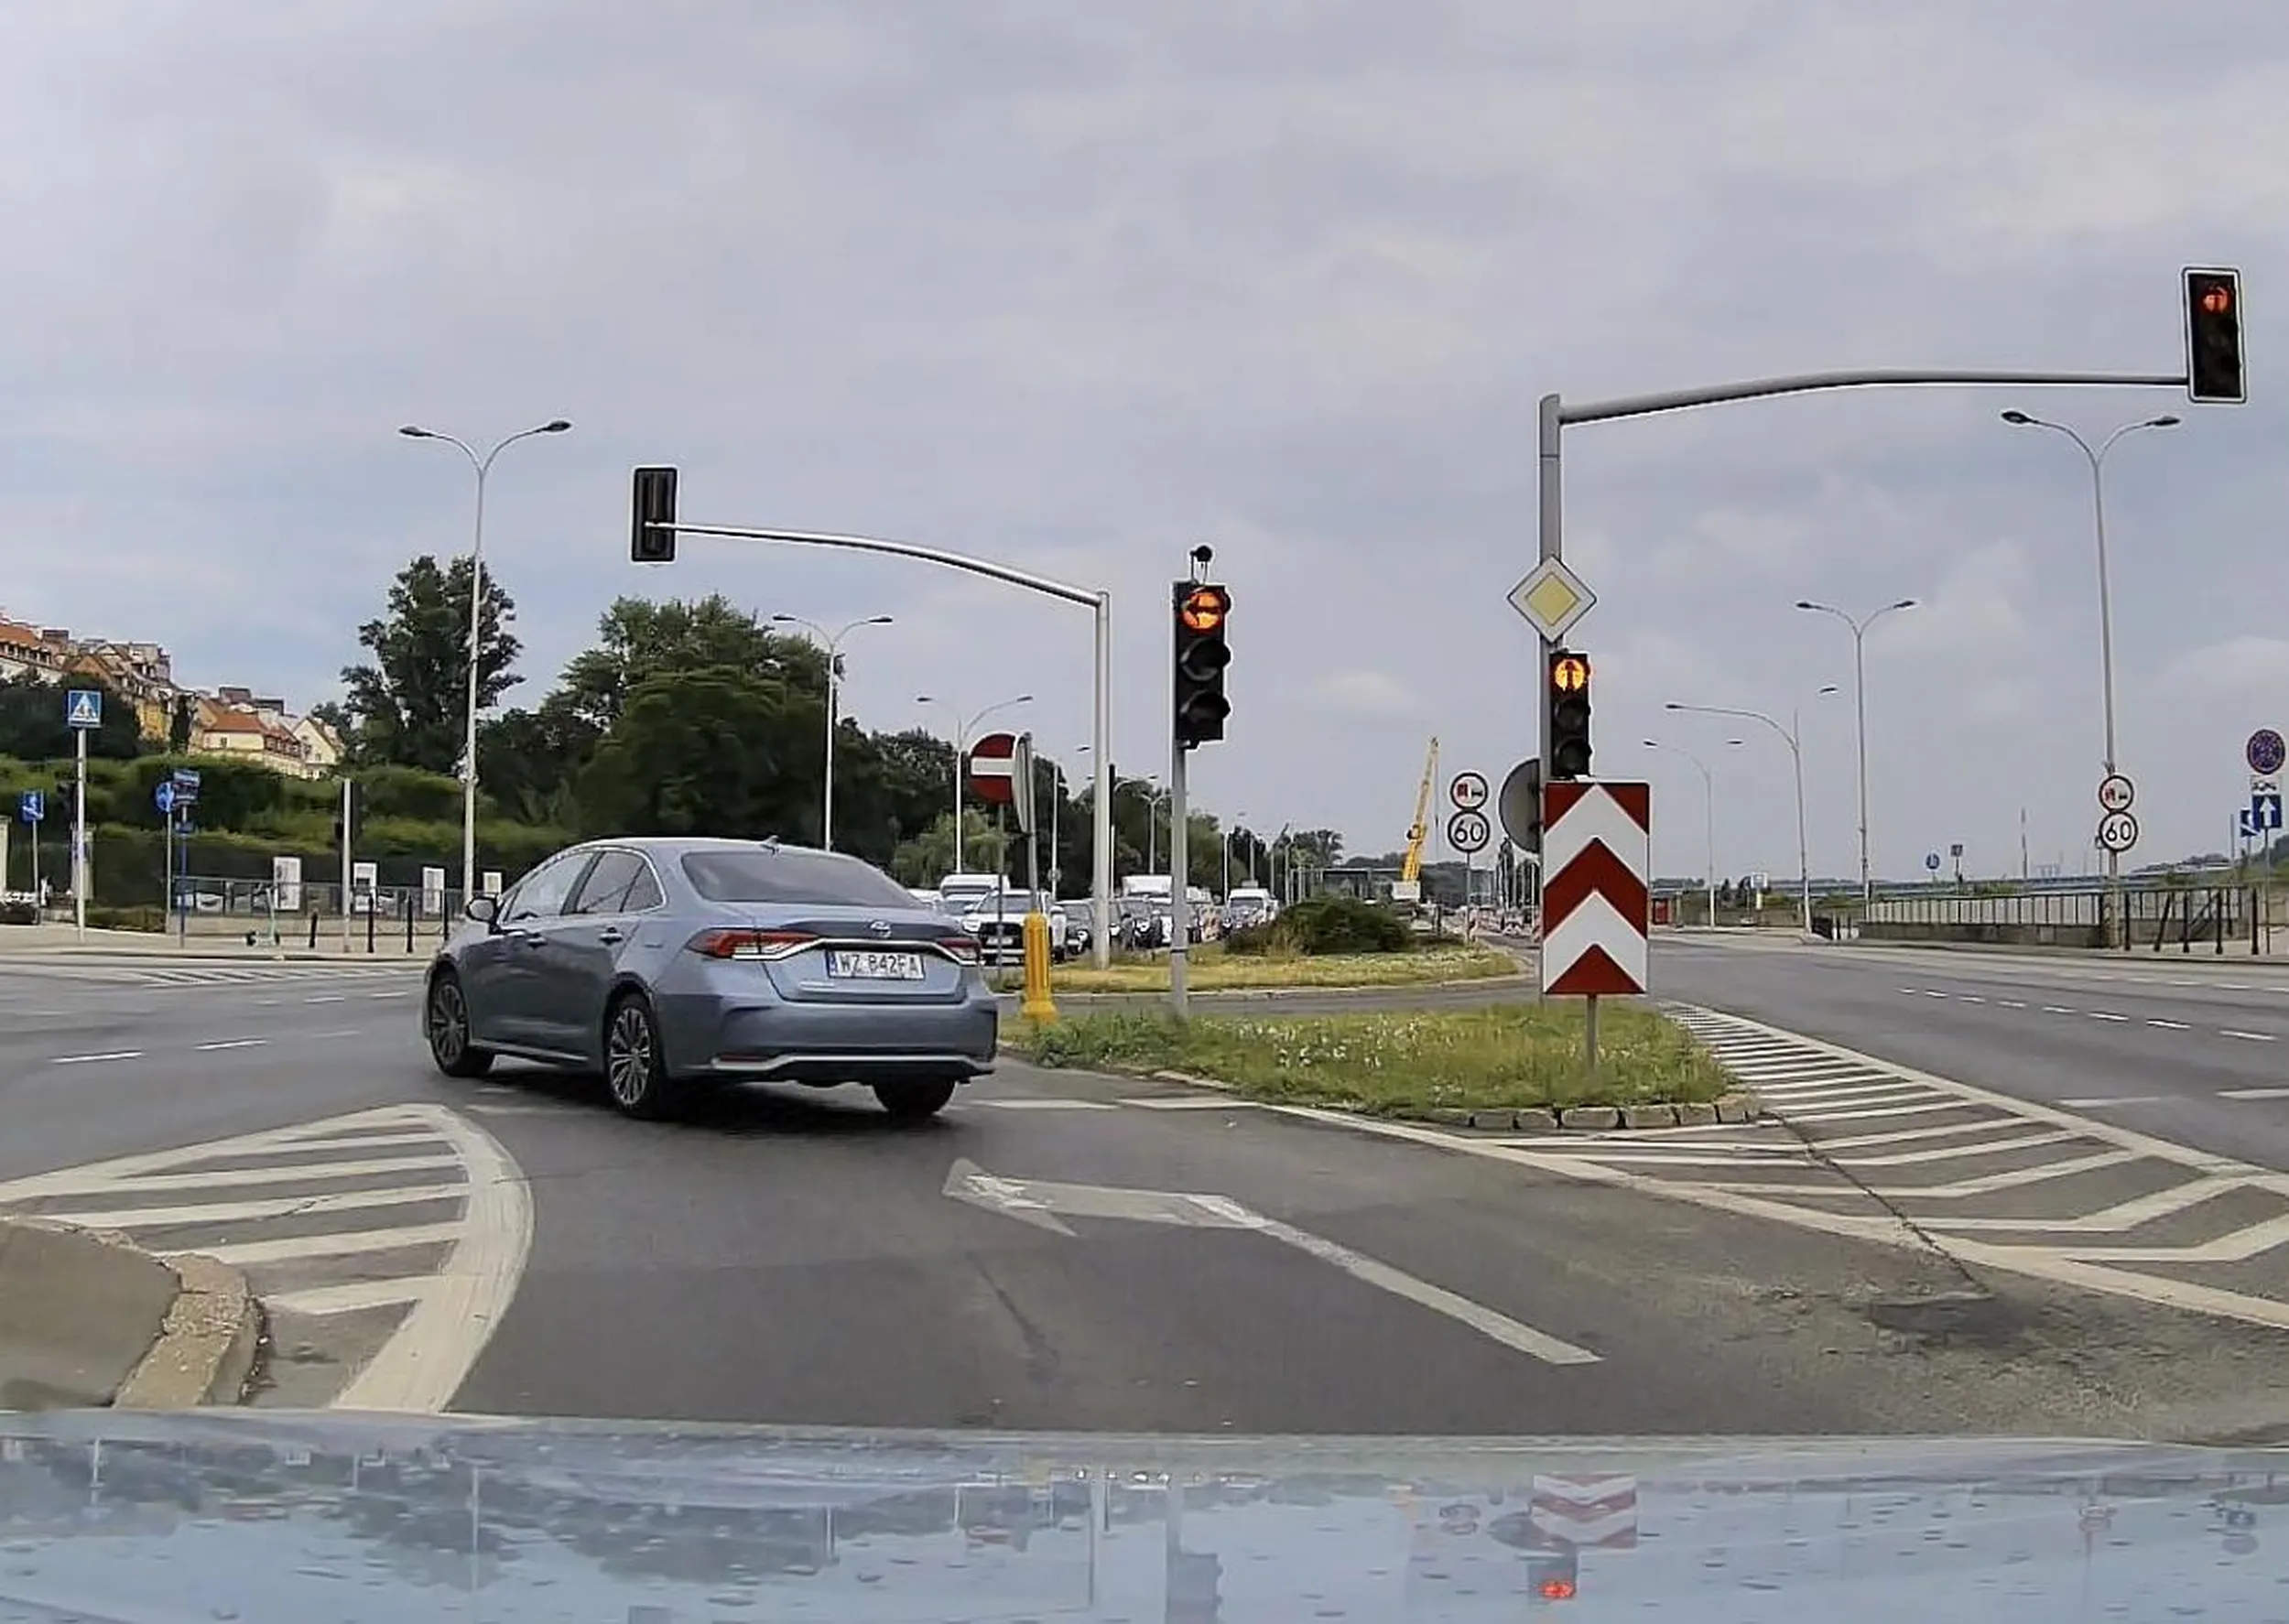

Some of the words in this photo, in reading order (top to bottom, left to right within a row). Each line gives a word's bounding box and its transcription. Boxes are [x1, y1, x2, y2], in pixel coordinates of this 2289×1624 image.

[1454, 819, 1483, 843] 60
[2106, 820, 2132, 842] 60
[840, 954, 861, 973] WZ
